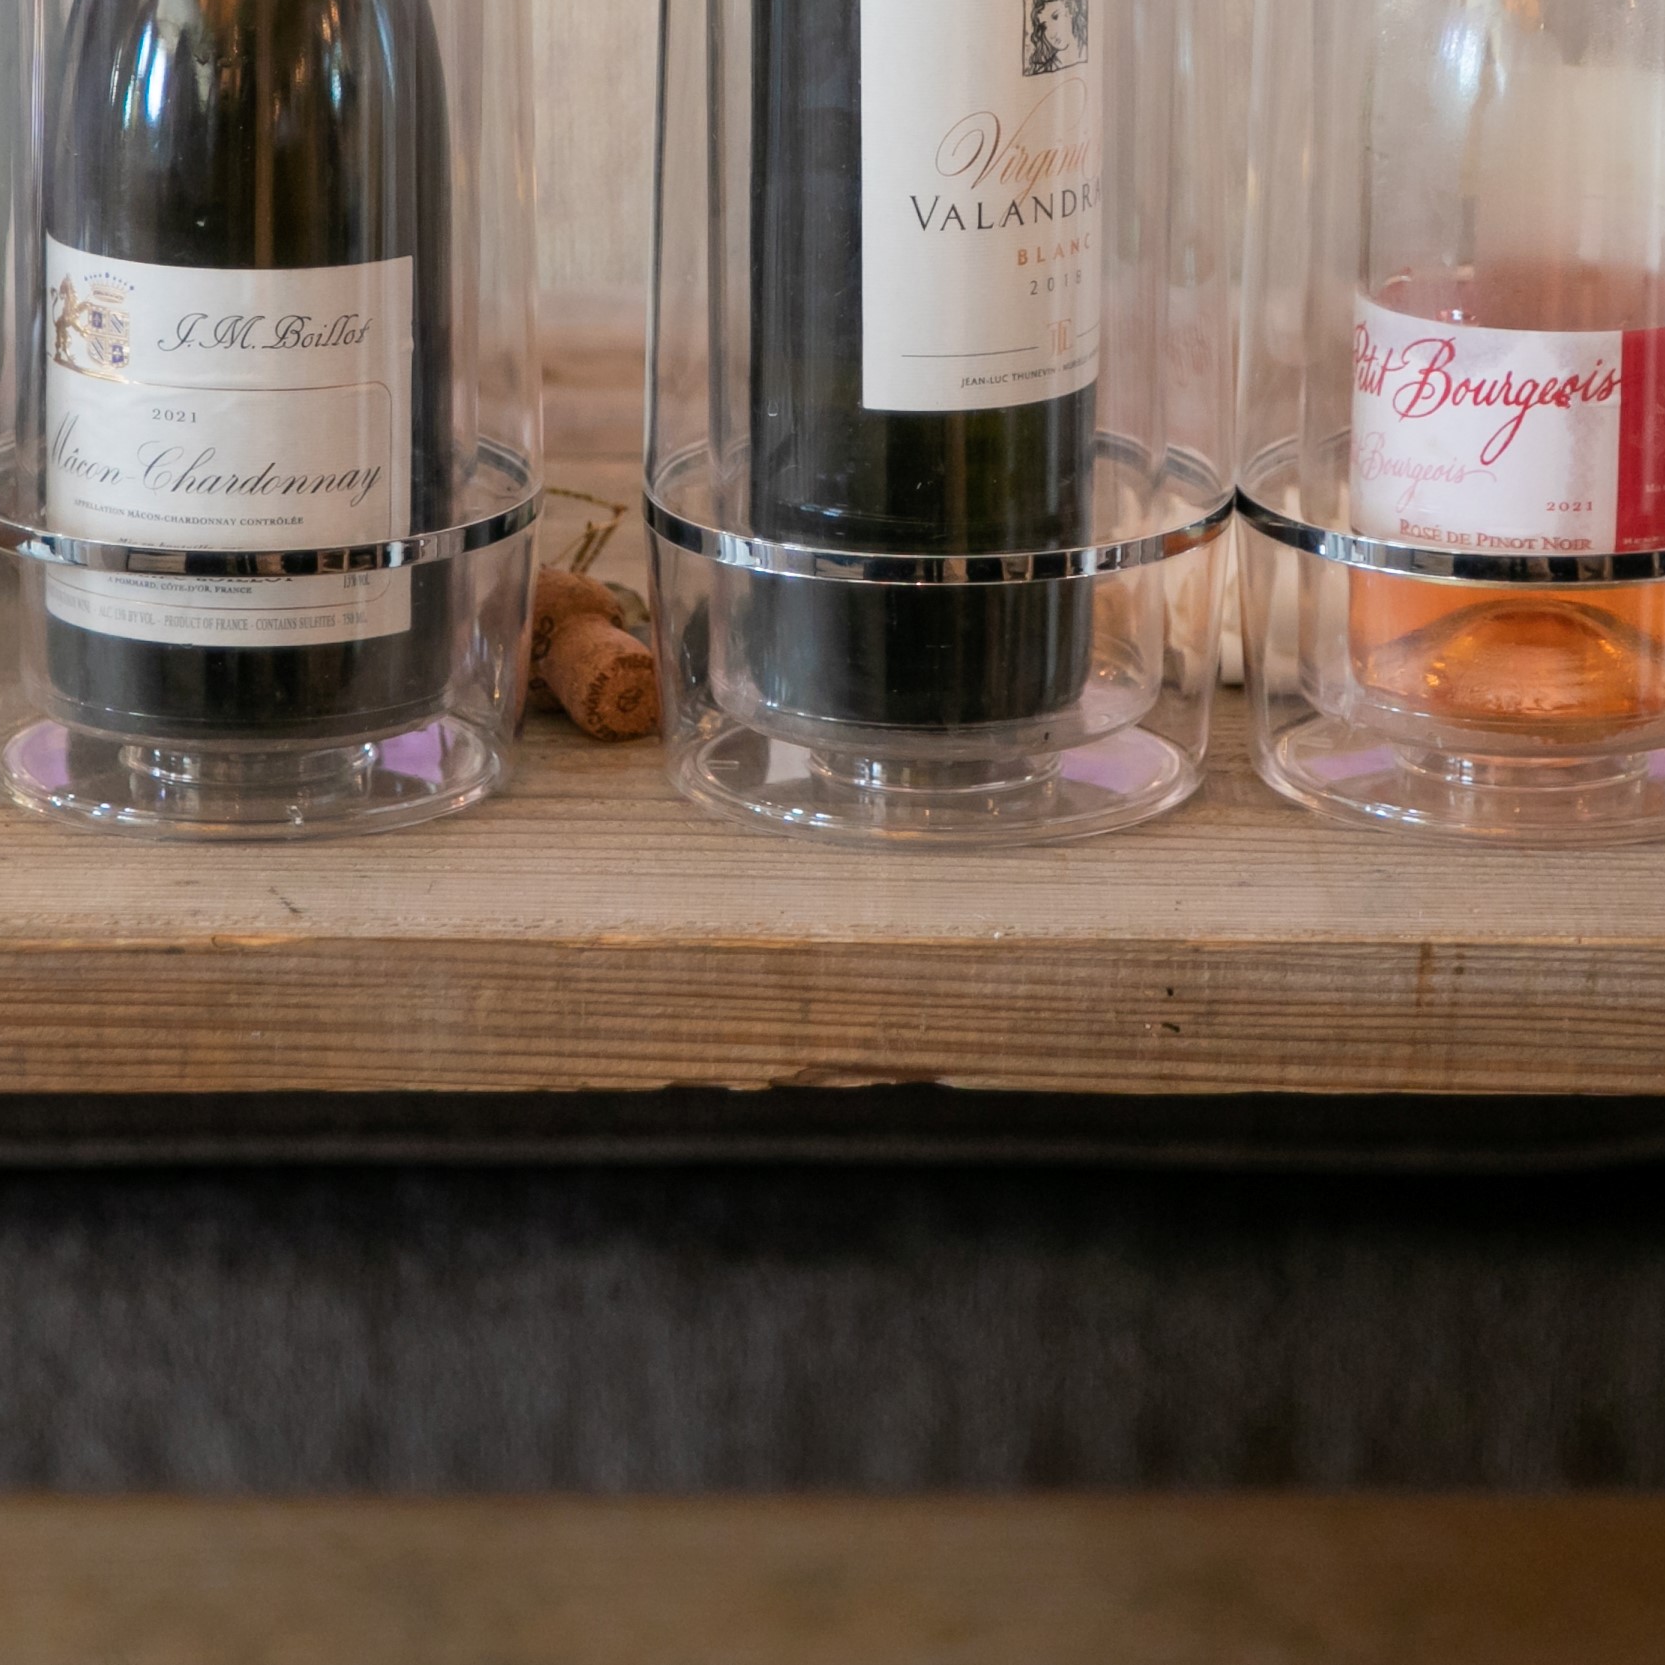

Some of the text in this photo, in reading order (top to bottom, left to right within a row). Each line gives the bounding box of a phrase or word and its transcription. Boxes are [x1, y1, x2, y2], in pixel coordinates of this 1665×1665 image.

[909, 181, 1102, 232] VALANDRA
[1017, 234, 1091, 267] BLANC
[1029, 271, 1083, 297] 2018
[262, 312, 374, 351] Boillot
[960, 374, 1008, 388] JEAN-LUC
[1393, 336, 1623, 466] Bourgeois
[151, 407, 199, 424] 2021
[73, 498, 305, 526] APPELLATION MÂCON-CHARDONNAY CONTRÔLÉE
[1545, 500, 1595, 513] 2021
[215, 586, 253, 594] FRANCE
[164, 615, 201, 628] PRODUCT
[202, 617, 214, 630] OF
[215, 618, 249, 631] FRANCE
[255, 618, 297, 631] CONTAINS
